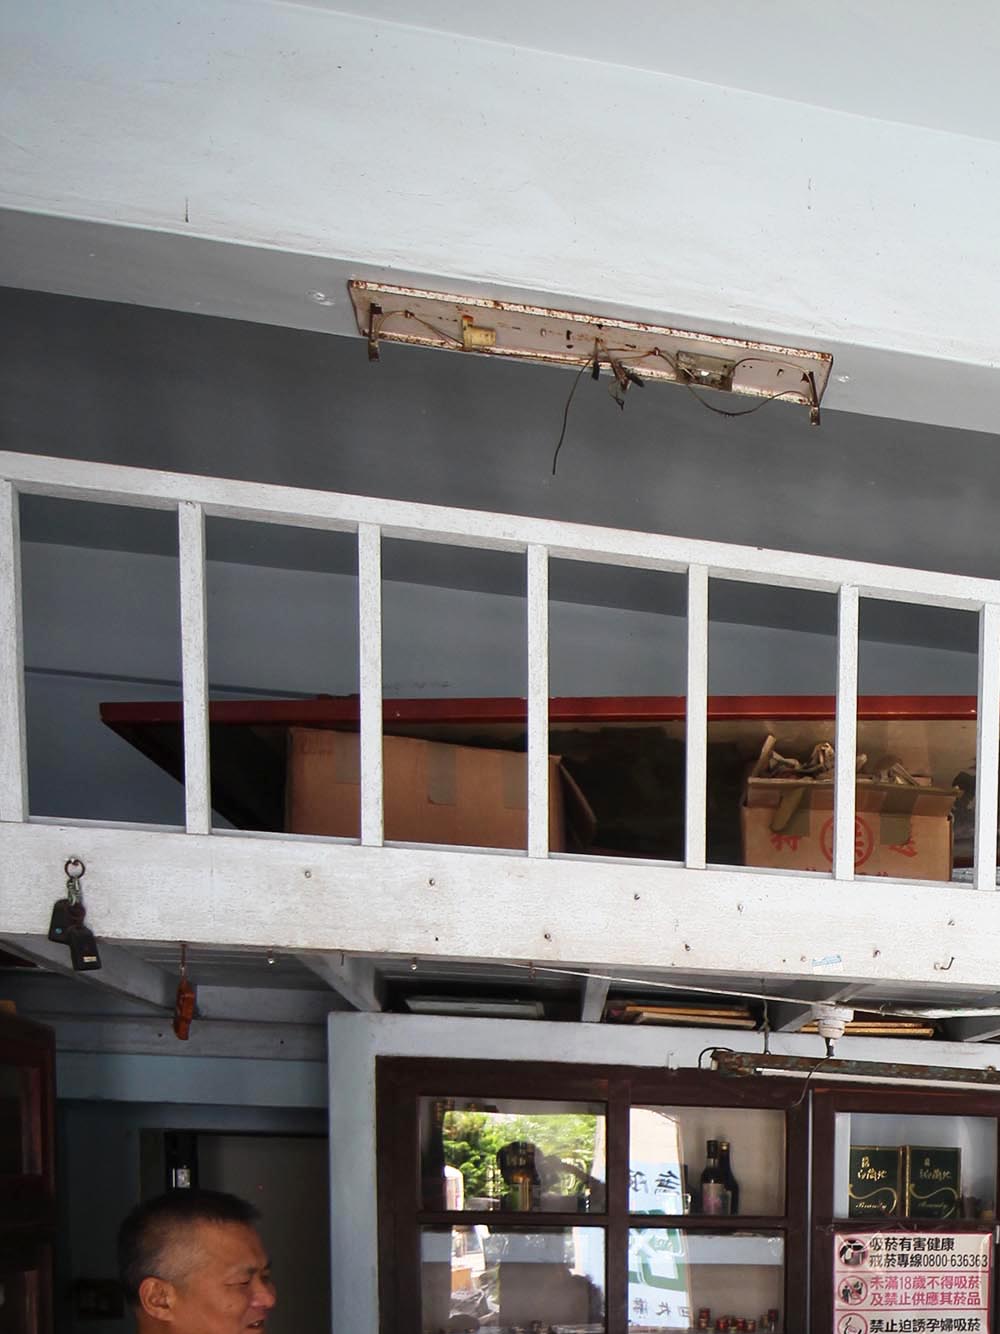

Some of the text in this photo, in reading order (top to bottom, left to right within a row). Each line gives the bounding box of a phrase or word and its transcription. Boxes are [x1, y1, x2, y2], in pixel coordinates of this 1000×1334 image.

[870, 1238, 955, 1251] 吸菸有害健康
[870, 1276, 980, 1290] 未滿18歲不得吸菸
[870, 1292, 981, 1306] 及禁止供應其菸品
